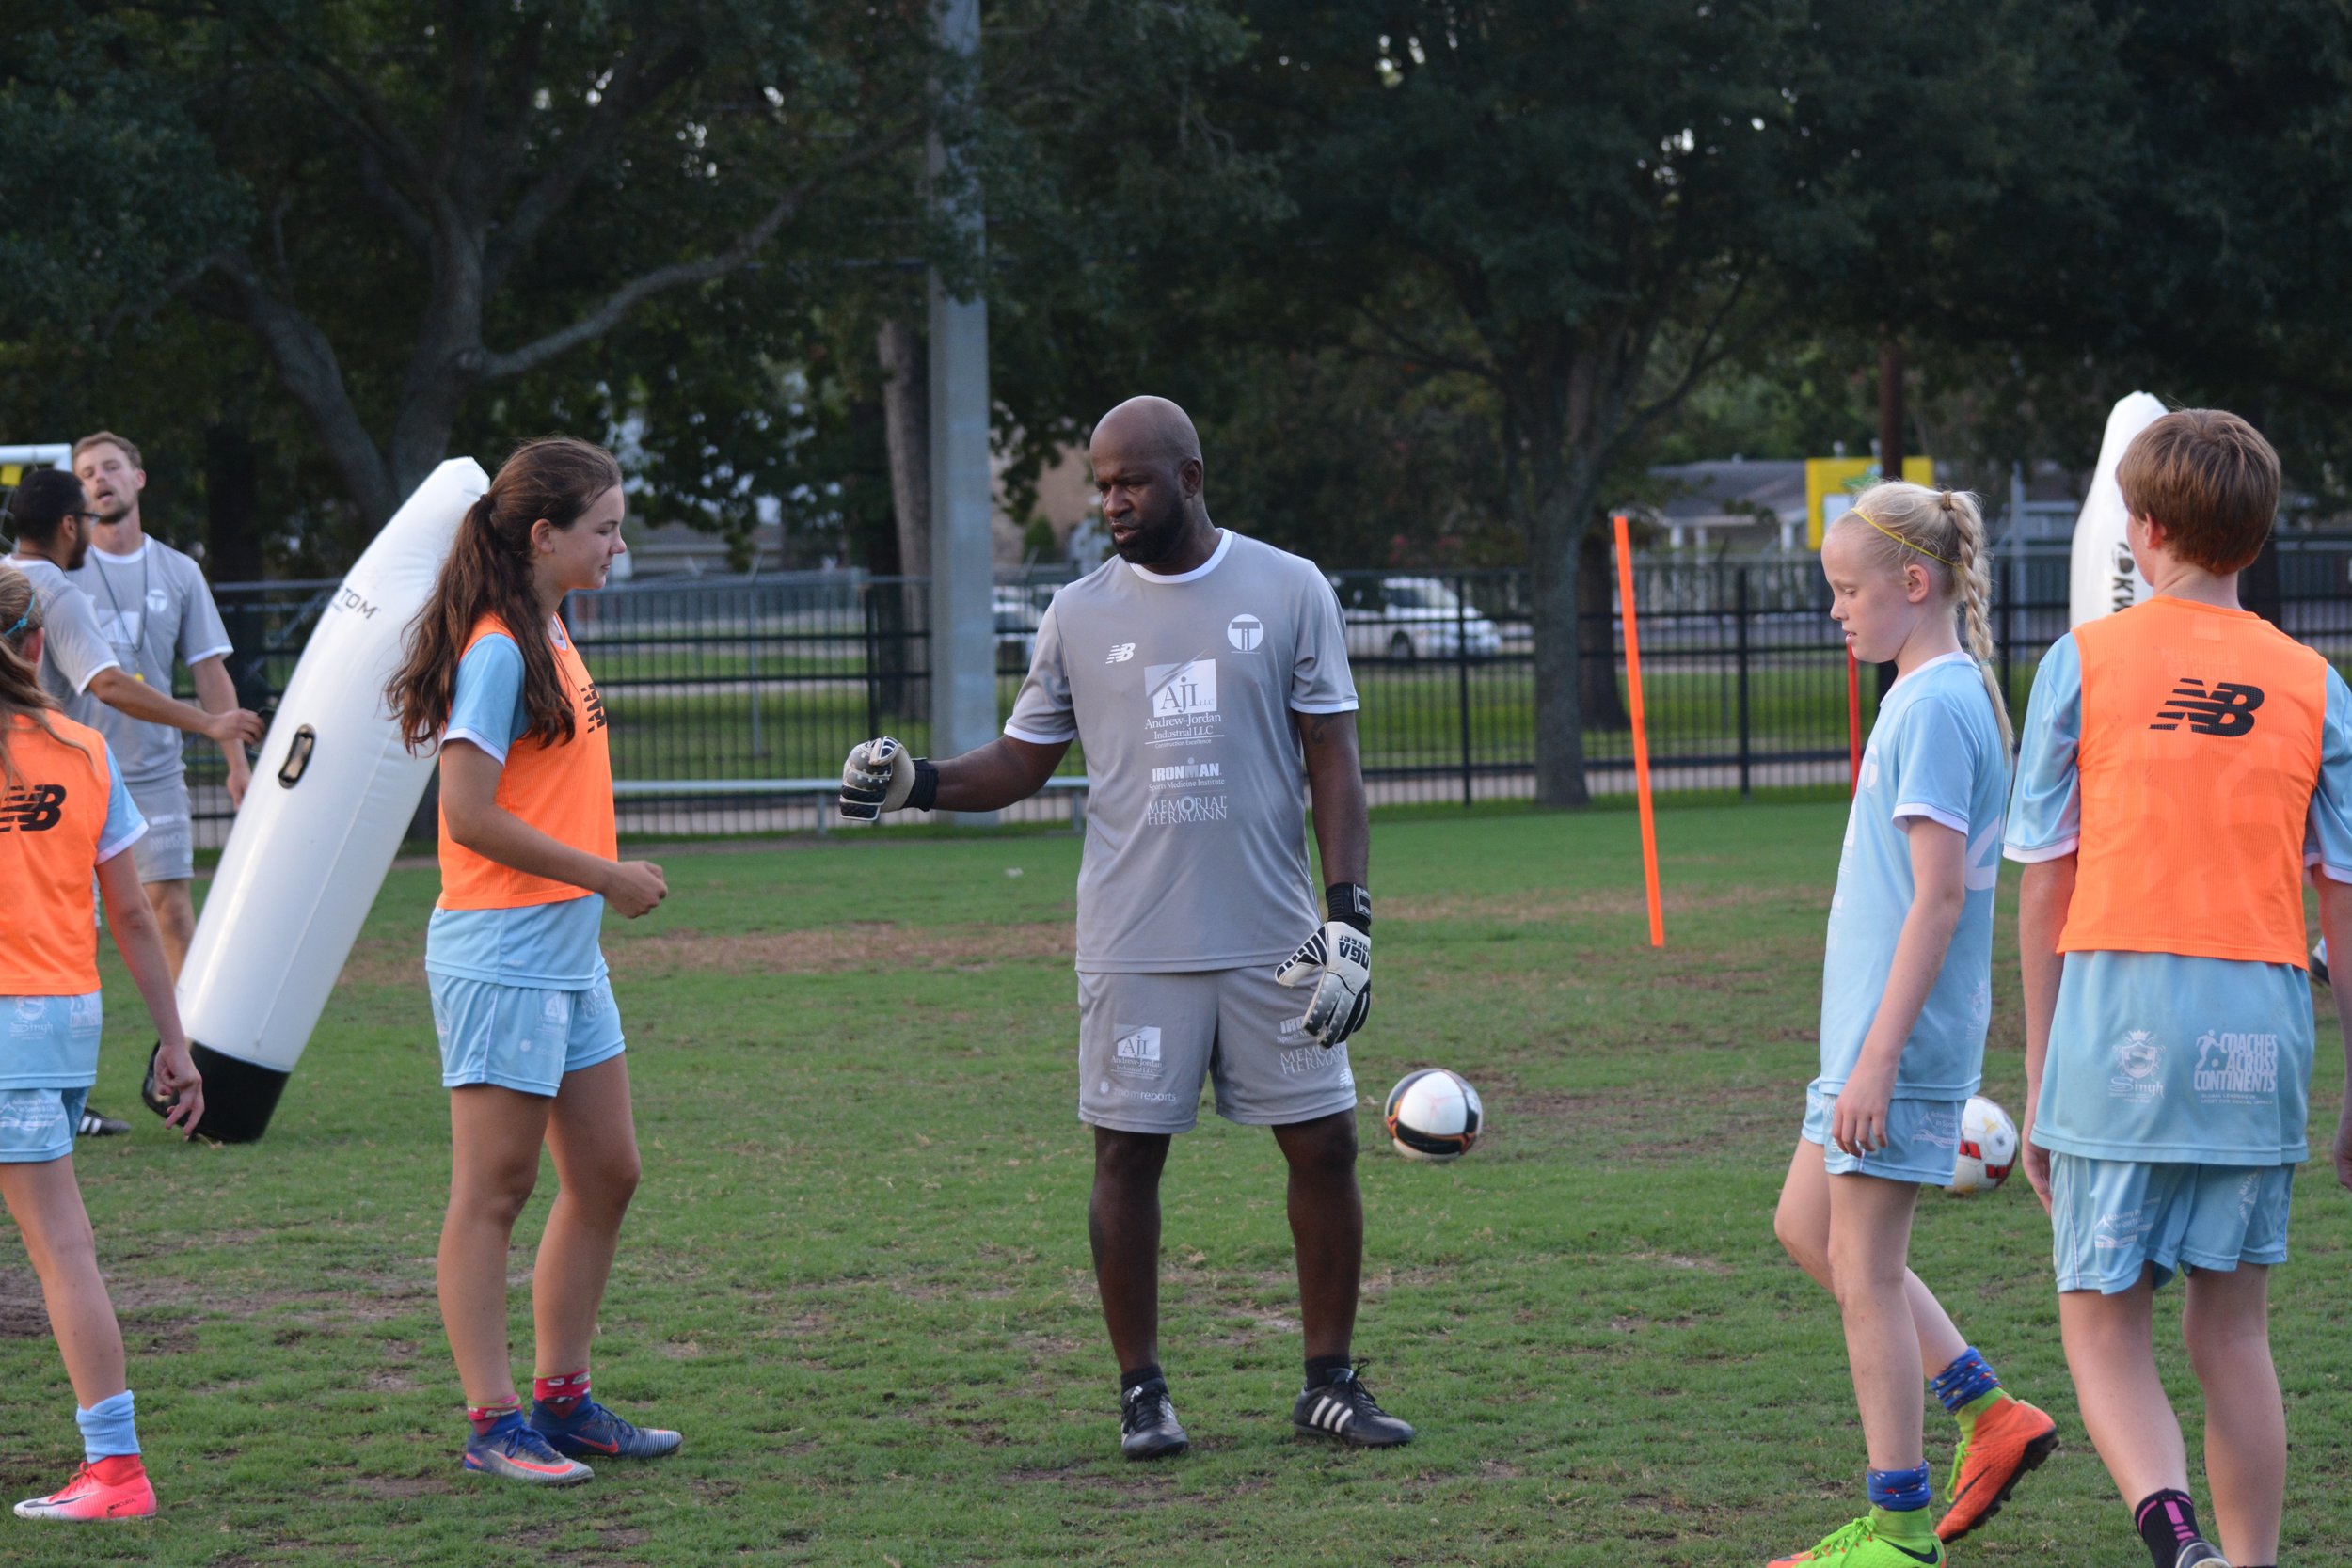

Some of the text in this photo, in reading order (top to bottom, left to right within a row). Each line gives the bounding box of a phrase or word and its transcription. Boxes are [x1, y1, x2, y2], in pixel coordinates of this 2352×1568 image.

[340, 587, 378, 619] TOM
[2149, 677, 2265, 737] NB
[1144, 712, 1221, 730] Andrew-Jordan
[1153, 725, 1214, 740] Industrial LLC
[1152, 761, 1220, 782] IRONMAN
[1148, 783, 1167, 793] Sports
[1167, 780, 1196, 789] Medicine
[1148, 795, 1228, 814] MEMORIAL
[1148, 807, 1227, 825] HERMANN
[2220, 1033, 2278, 1054] COACHES
[2226, 1053, 2278, 1073] ACROSS
[2108, 1076, 2165, 1099] Singh
[2194, 1070, 2277, 1092] CONTINENTS
